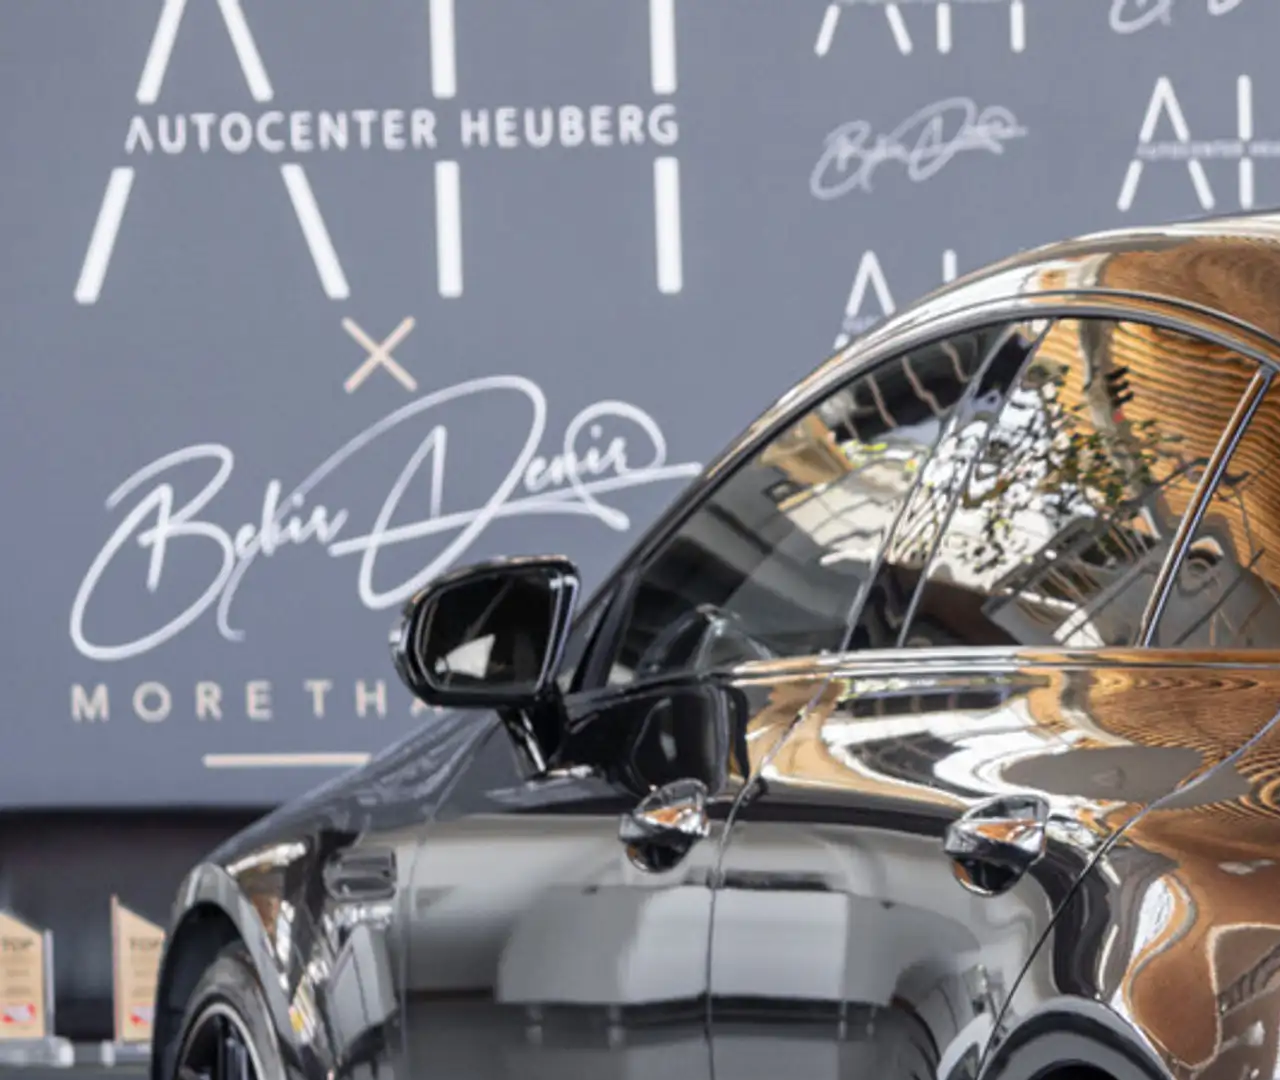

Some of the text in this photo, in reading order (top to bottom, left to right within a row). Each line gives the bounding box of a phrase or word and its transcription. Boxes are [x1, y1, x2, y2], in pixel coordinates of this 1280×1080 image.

[125, 103, 680, 155] AUTOCENTER HEUBERG
[71, 680, 273, 723] MORE
